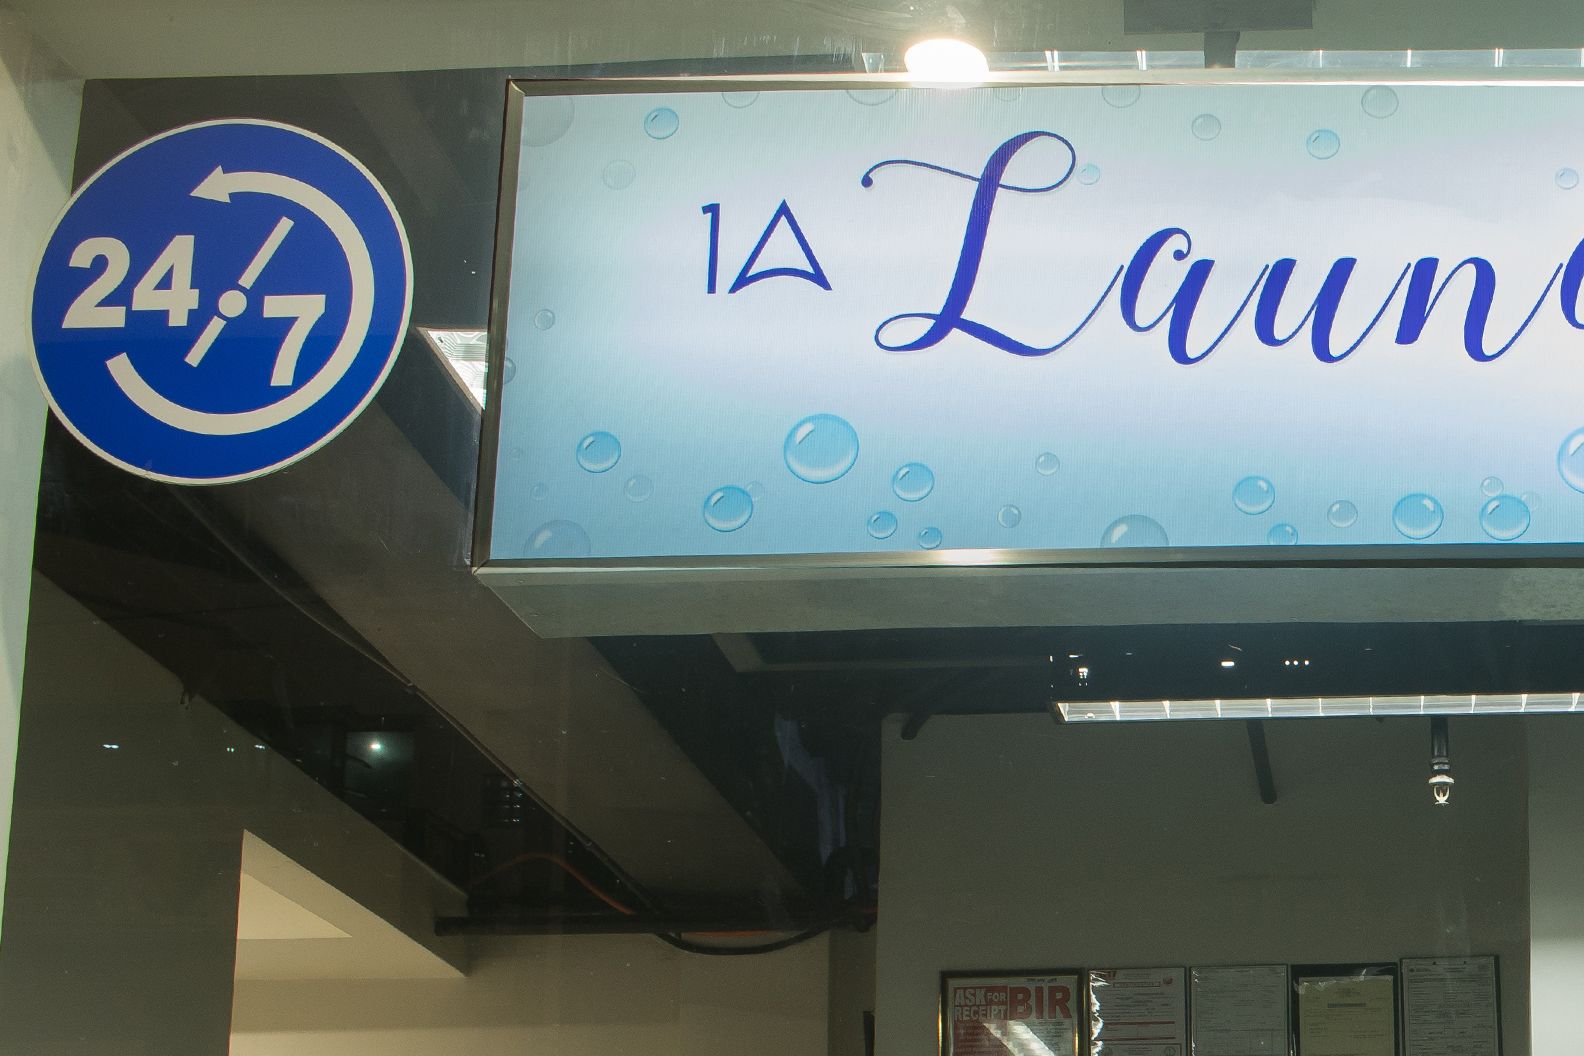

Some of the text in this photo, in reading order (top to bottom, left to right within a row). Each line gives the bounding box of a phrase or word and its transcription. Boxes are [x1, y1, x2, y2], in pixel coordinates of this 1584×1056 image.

[954, 988, 1007, 1006] ASK FOR
[1008, 985, 1072, 1020] BIR
[954, 1005, 1007, 1021] RECEIPT
